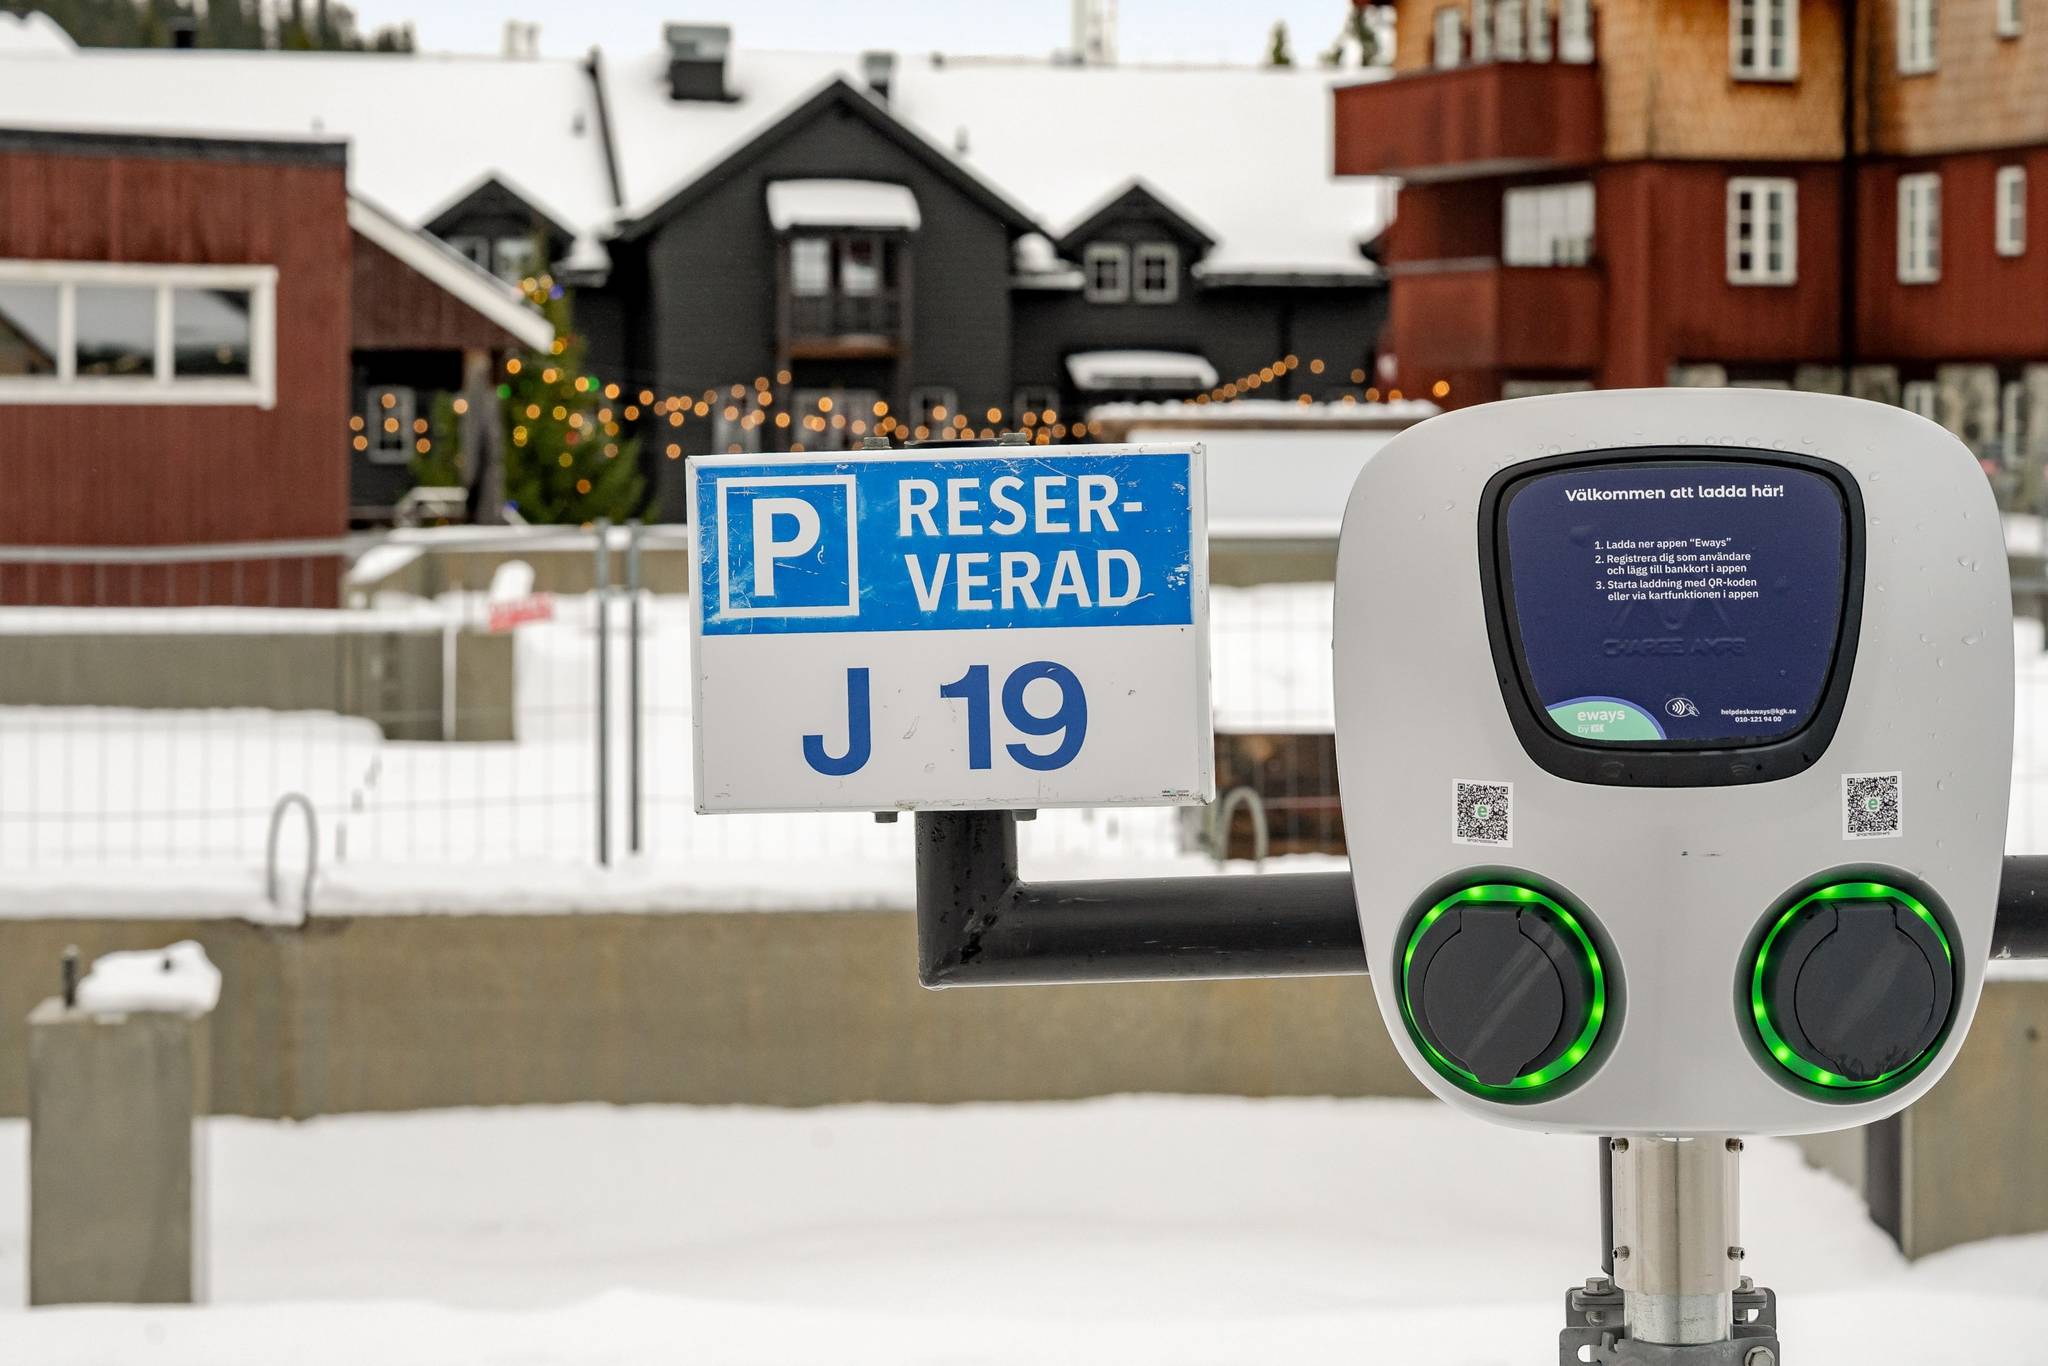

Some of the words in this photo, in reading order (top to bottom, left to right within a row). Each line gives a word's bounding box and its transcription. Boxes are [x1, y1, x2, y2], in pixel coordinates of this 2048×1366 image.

[1565, 488, 1666, 502] Välkommen
[1670, 487, 1694, 498] att
[1698, 485, 1747, 498] ladda
[1751, 484, 1784, 498] här!
[899, 474, 1143, 537] RESER-
[752, 497, 821, 598] P
[1594, 541, 1604, 550] 1.
[1606, 540, 1636, 549] Ladda
[1638, 540, 1654, 548] ner
[1656, 539, 1687, 549] appen
[1595, 555, 1605, 564] 2.
[1607, 554, 1657, 564] Registrera
[1659, 553, 1675, 563] dig
[1677, 554, 1697, 562] som
[1699, 552, 1751, 561] användare
[1607, 566, 1625, 575] och
[1627, 566, 1648, 577] lägg
[1650, 565, 1663, 574] till
[1665, 564, 1708, 573] bankkort
[1710, 564, 1714, 572] i
[1716, 565, 1747, 574] appen
[904, 549, 1142, 612] VERAD
[1596, 581, 1605, 590] 3.
[1607, 580, 1638, 589] Starta
[1640, 579, 1683, 589] laddning
[1684, 579, 1706, 587] med
[1708, 578, 1757, 588] QR-koden
[1608, 592, 1630, 601] eller
[1632, 591, 1646, 600] via
[1649, 590, 1721, 600] kartfunktionen
[1723, 590, 1727, 599] i
[1728, 590, 1759, 600] appen
[802, 667, 872, 776] J
[940, 660, 1088, 772] 19
[1577, 710, 1626, 723] eways
